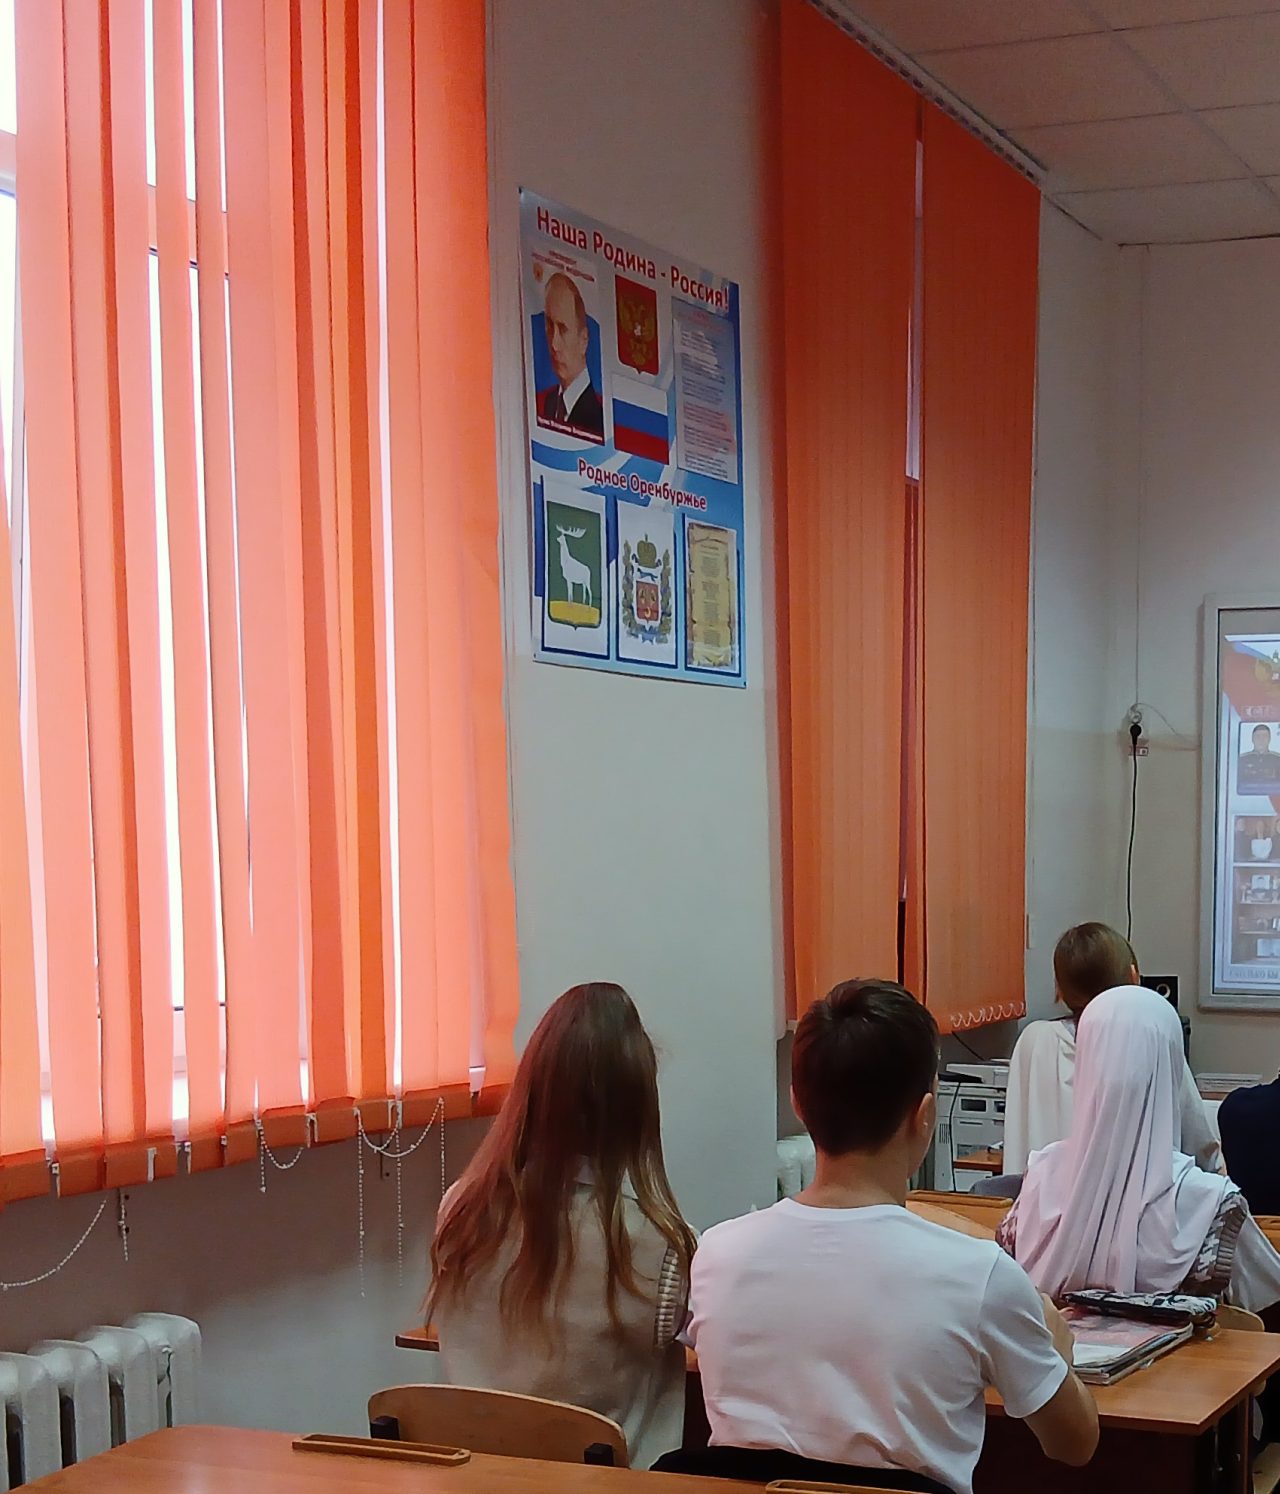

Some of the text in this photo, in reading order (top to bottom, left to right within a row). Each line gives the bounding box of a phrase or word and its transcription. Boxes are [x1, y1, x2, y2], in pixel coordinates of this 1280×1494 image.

[537, 206, 588, 250] Наша
[593, 232, 656, 279] Родина
[670, 266, 729, 310] Россия!
[578, 458, 707, 512] Родное Оренбуржье
